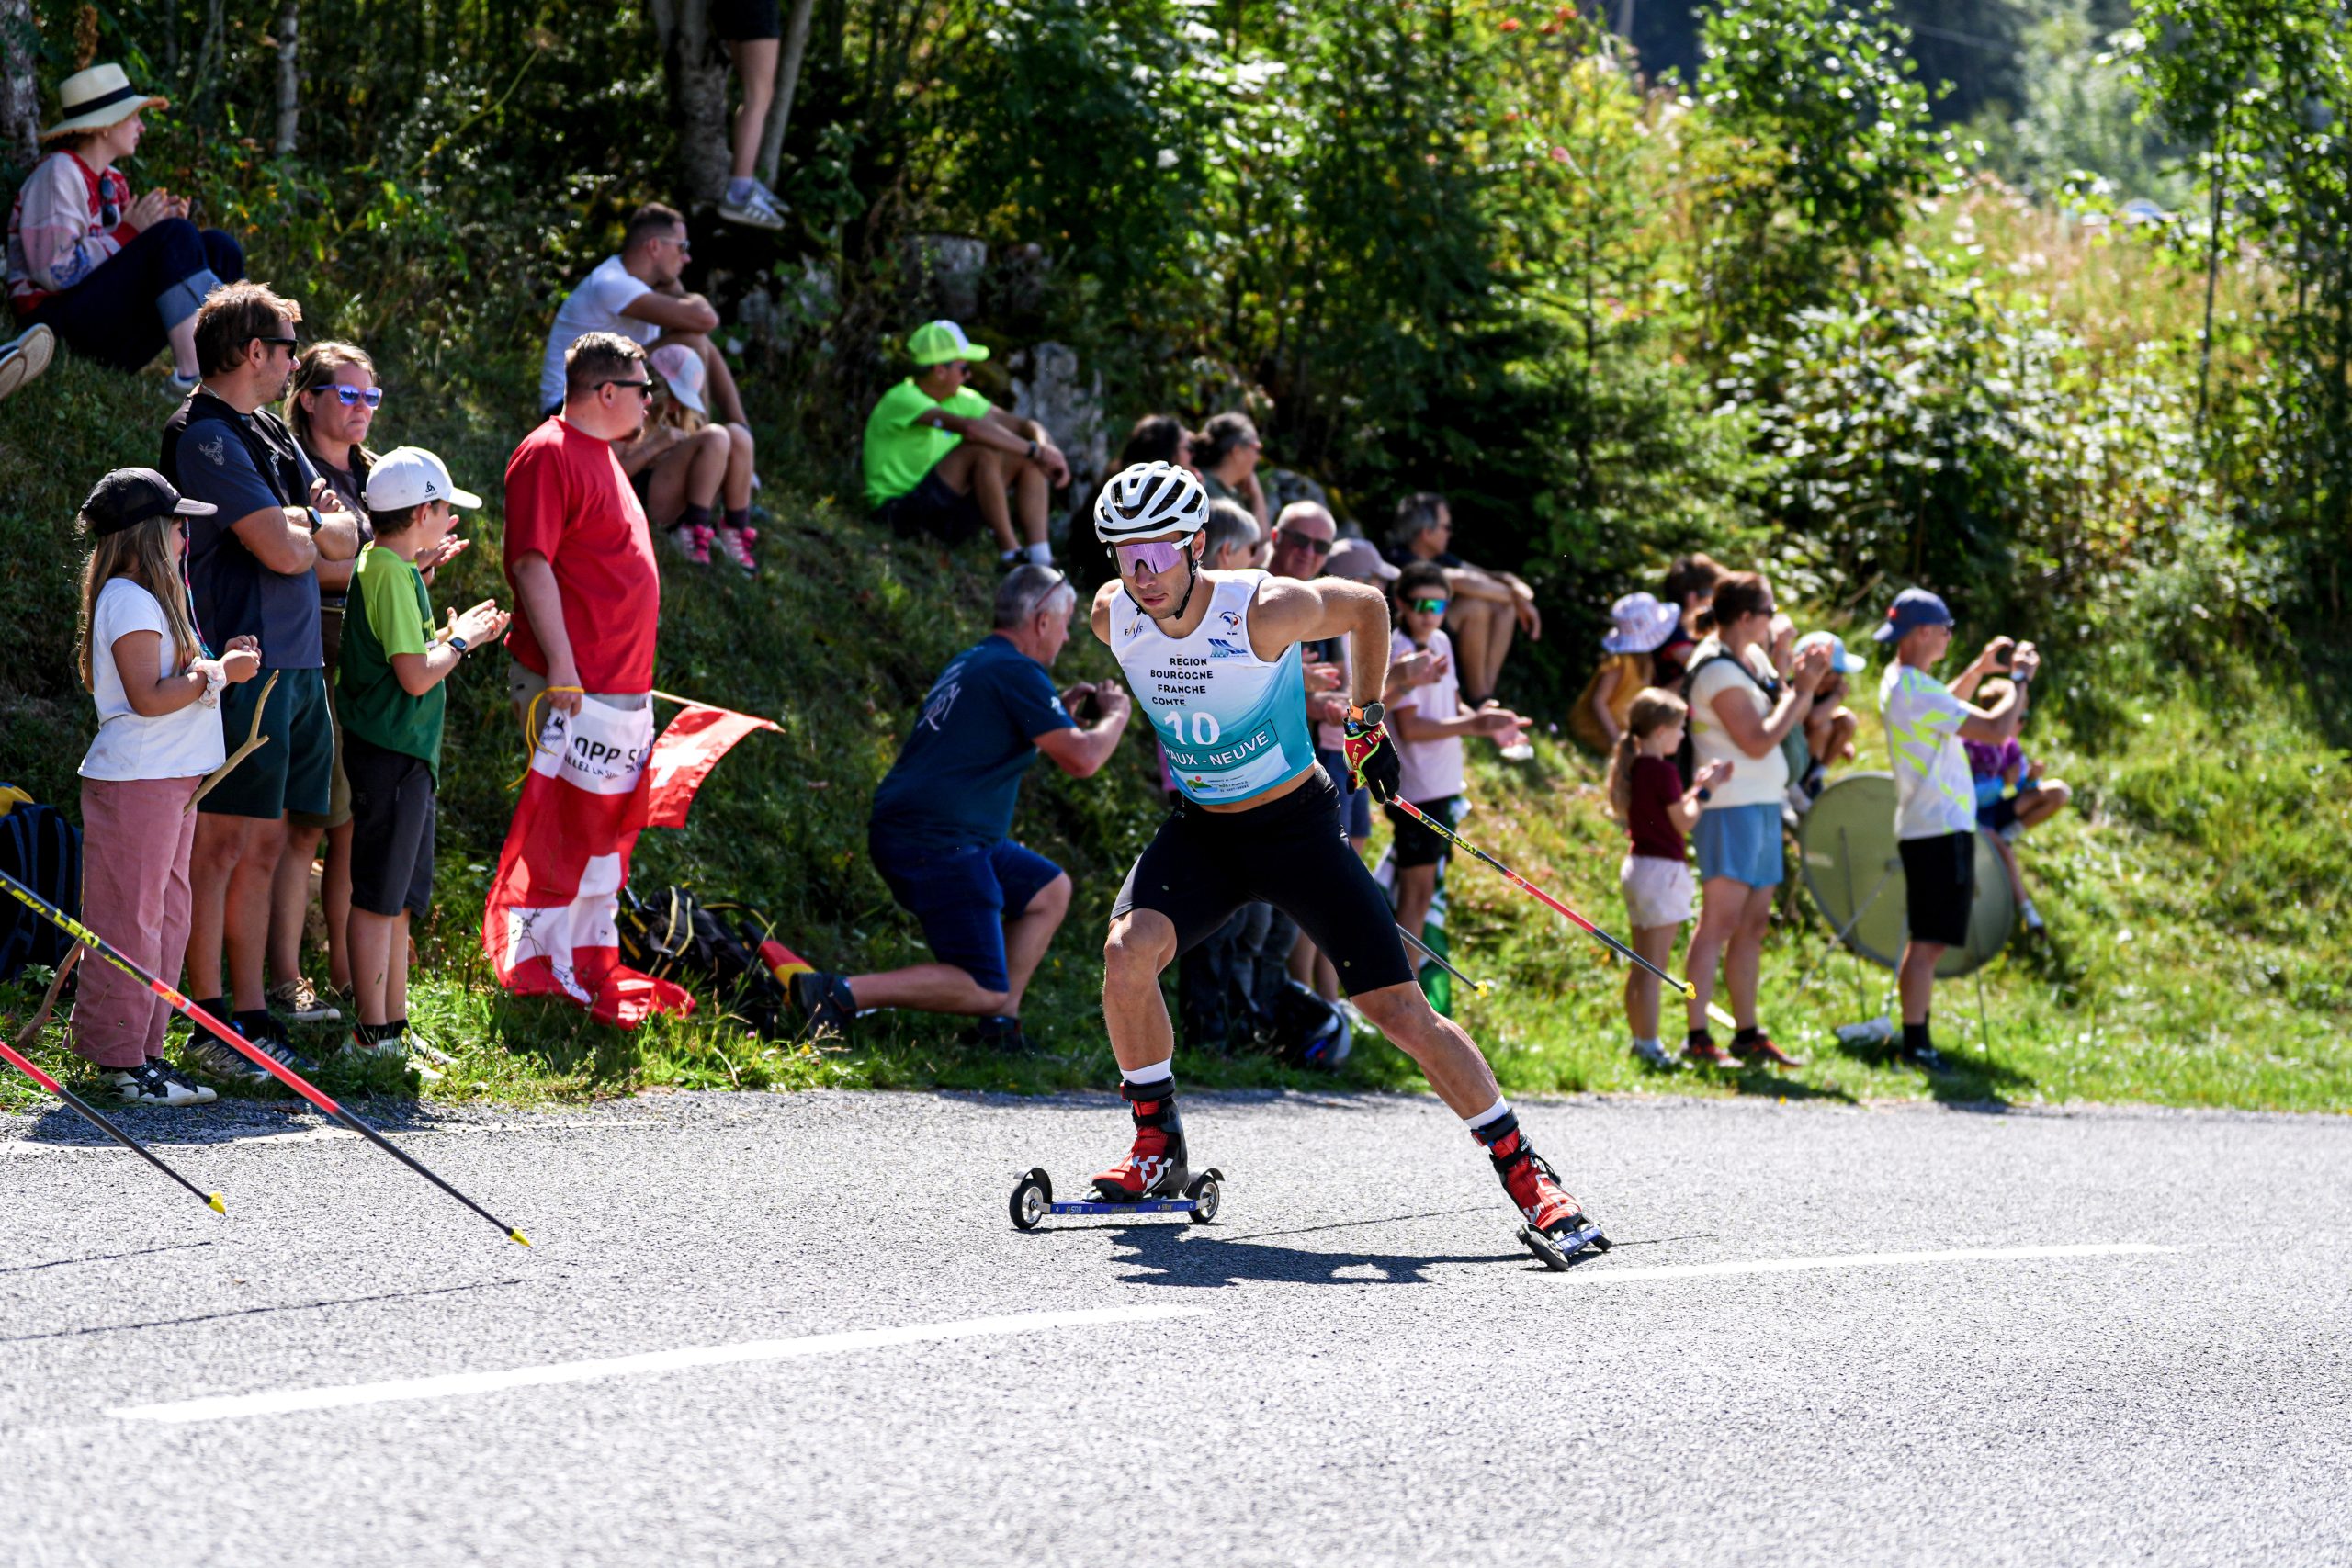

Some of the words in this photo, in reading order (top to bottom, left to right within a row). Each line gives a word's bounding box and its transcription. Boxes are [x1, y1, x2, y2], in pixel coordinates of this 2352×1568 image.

[1170, 657, 1207, 666] REGION
[1150, 670, 1213, 680] BOURGOGNE
[1158, 684, 1206, 694] FRANCHE
[1151, 696, 1186, 706] COMTE
[1164, 710, 1220, 745] 10
[571, 736, 621, 764] OPP
[1161, 743, 1198, 765] HAUX
[1209, 730, 1269, 765] NEUVE
